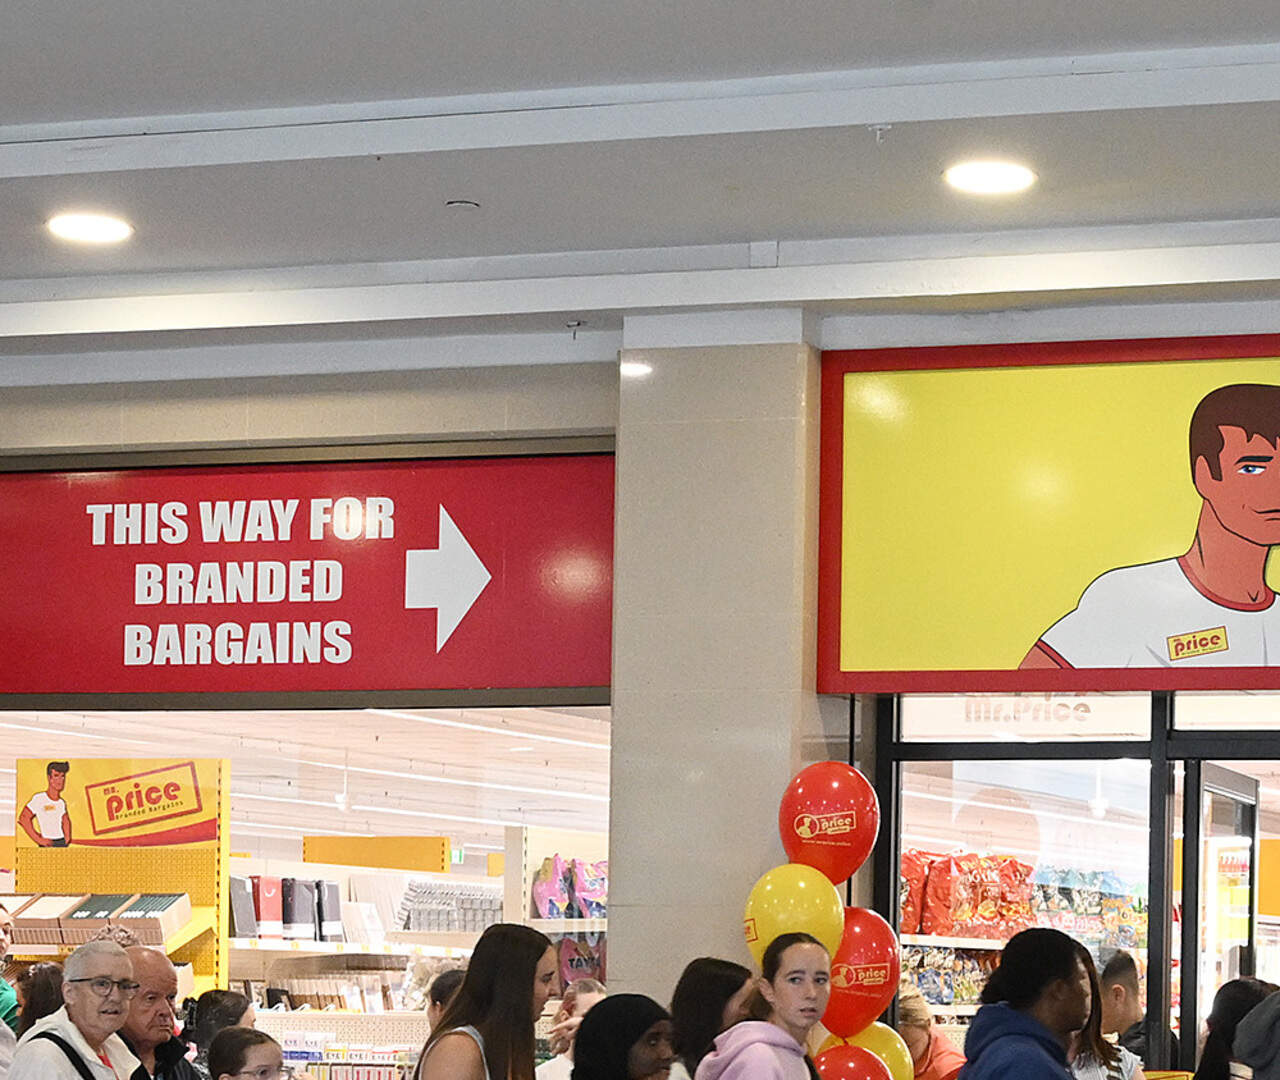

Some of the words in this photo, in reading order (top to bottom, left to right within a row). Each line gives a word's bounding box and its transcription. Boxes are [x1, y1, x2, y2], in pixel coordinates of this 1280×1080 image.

[86, 502, 188, 546] THIS
[198, 500, 299, 543] WAY
[310, 497, 395, 541] FOR
[134, 560, 343, 605] BRANDED
[123, 620, 352, 666] BARGAINS
[1175, 635, 1221, 656] price
[106, 782, 181, 821] price
[821, 816, 852, 832] price
[857, 968, 886, 982] price
